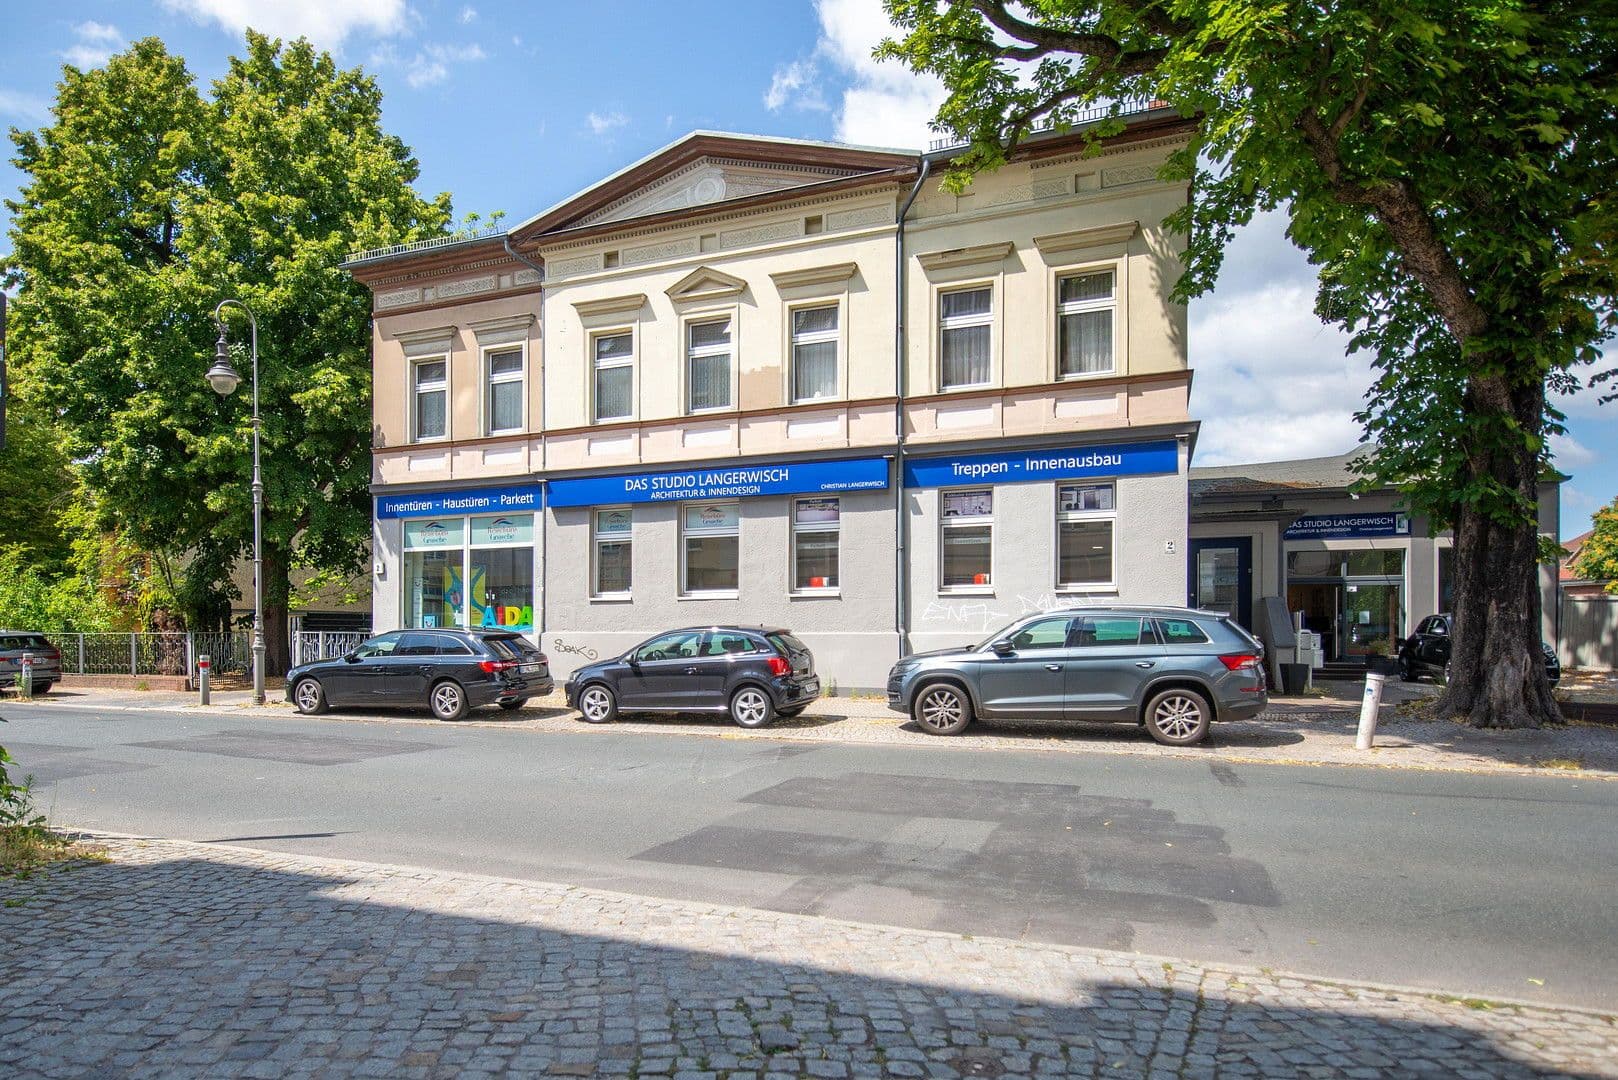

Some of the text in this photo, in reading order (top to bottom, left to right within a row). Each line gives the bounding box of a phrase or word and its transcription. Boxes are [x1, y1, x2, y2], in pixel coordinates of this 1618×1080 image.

[951, 462, 1009, 478] Treppen
[1026, 453, 1122, 472] Innenausbau
[625, 468, 789, 491] DAS STUDIO LANGERWISCH
[848, 480, 885, 489] LANGERWISCH
[651, 485, 760, 499] ARCHITEKTUR & INNENDESIGN
[386, 500, 432, 512] Innentüren
[443, 497, 489, 509] Haustüren
[500, 493, 534, 506] Parkett
[1303, 519, 1332, 528] STUDIO
[1333, 516, 1394, 527] LANGERWISCH
[1167, 541, 1173, 549] 2
[482, 605, 534, 627] AIDA
